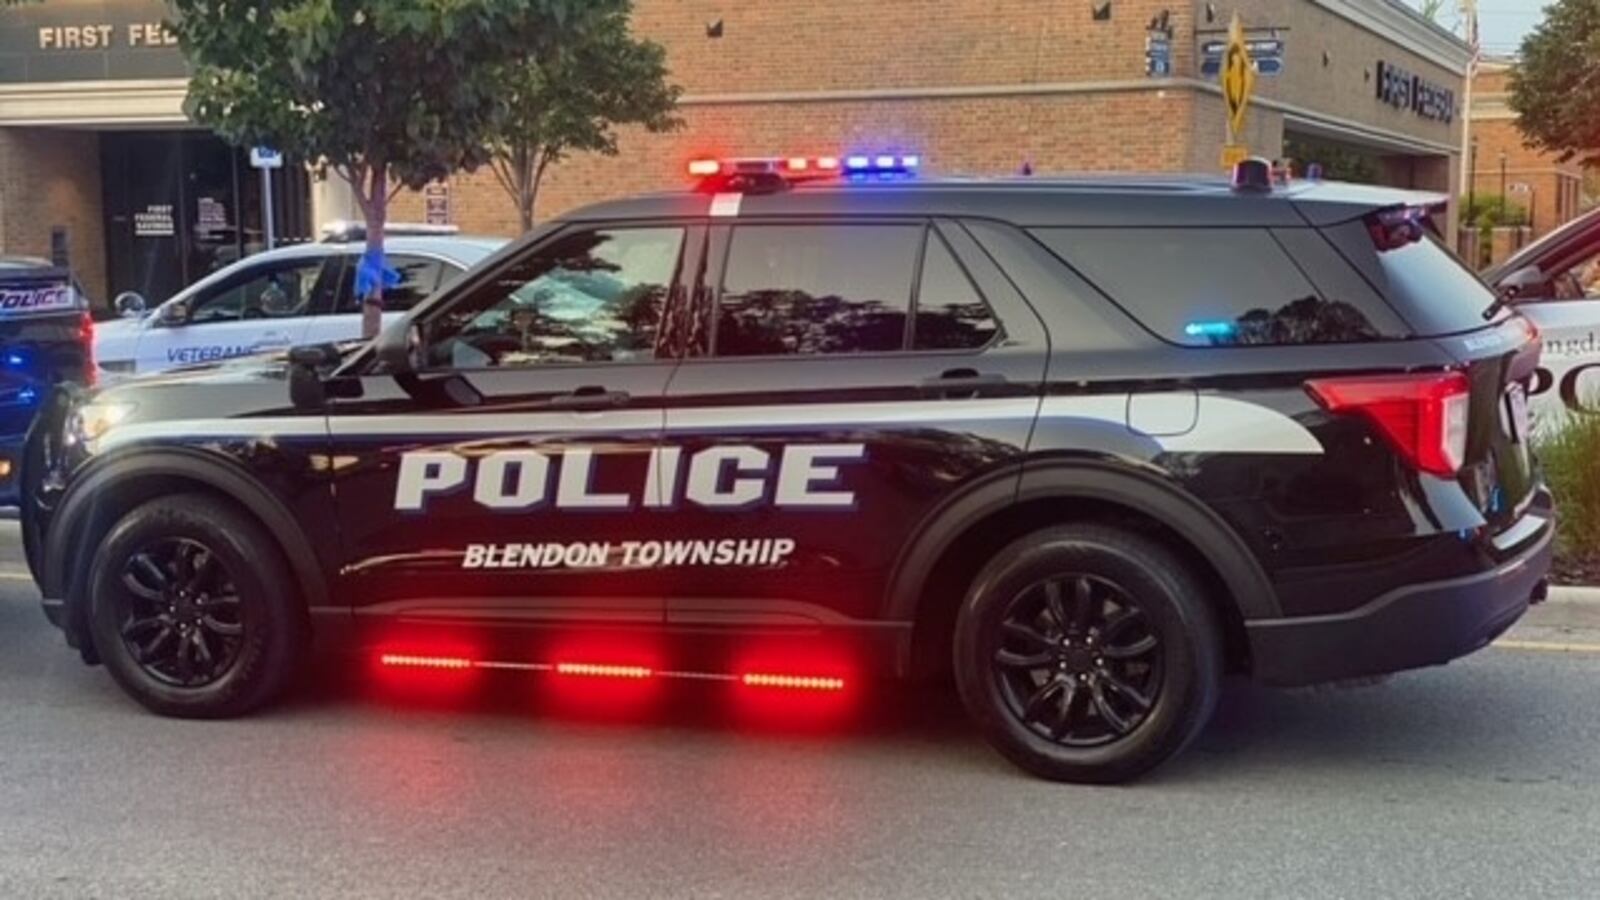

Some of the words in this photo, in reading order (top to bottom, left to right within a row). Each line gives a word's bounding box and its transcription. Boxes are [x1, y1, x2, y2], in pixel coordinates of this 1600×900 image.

[39, 26, 113, 49] FIRST
[394, 443, 867, 511] POLICE
[462, 541, 611, 568] BLENDON
[620, 538, 796, 566] TOWNSHIP
